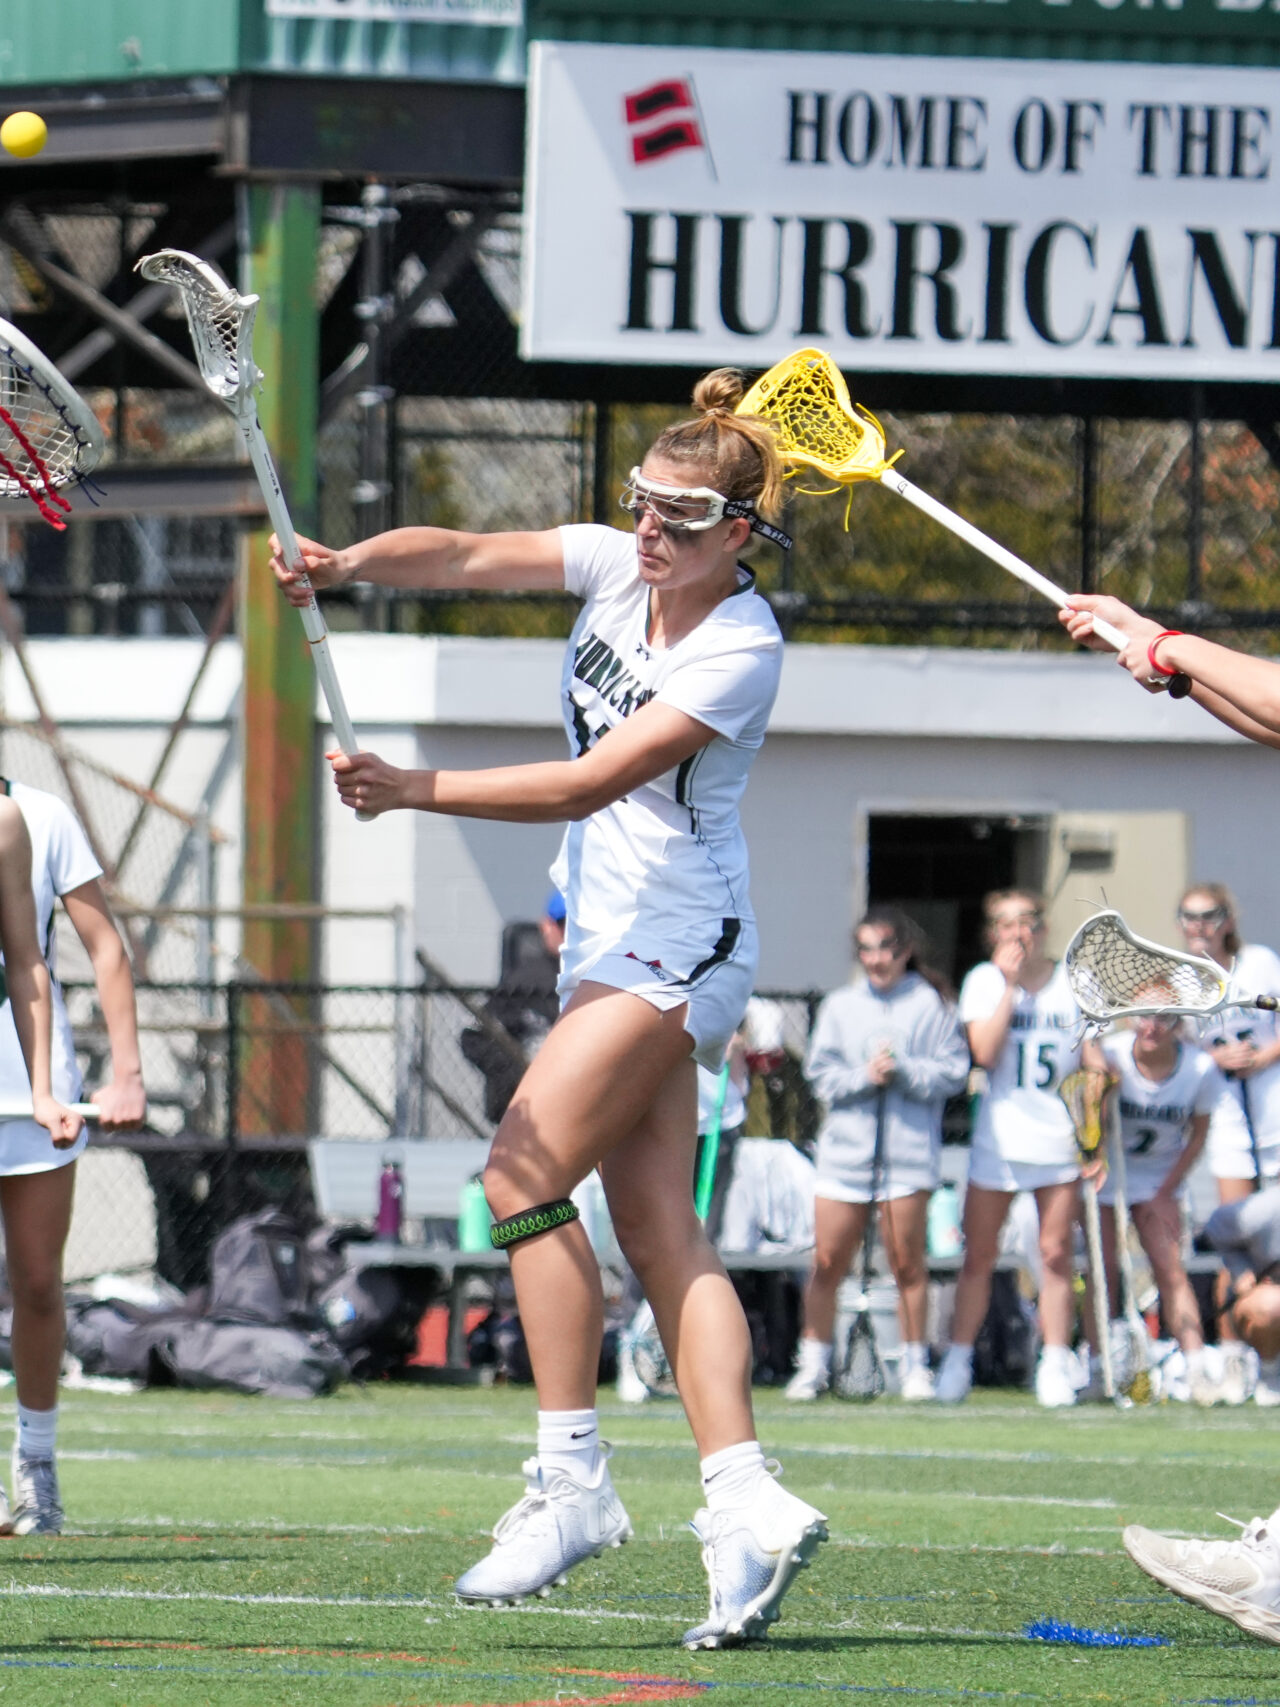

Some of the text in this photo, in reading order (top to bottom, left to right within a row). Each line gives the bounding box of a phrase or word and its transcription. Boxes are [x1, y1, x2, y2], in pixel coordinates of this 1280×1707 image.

[786, 89, 1273, 181] HOME OF THE
[1016, 1042, 1056, 1089] 15
